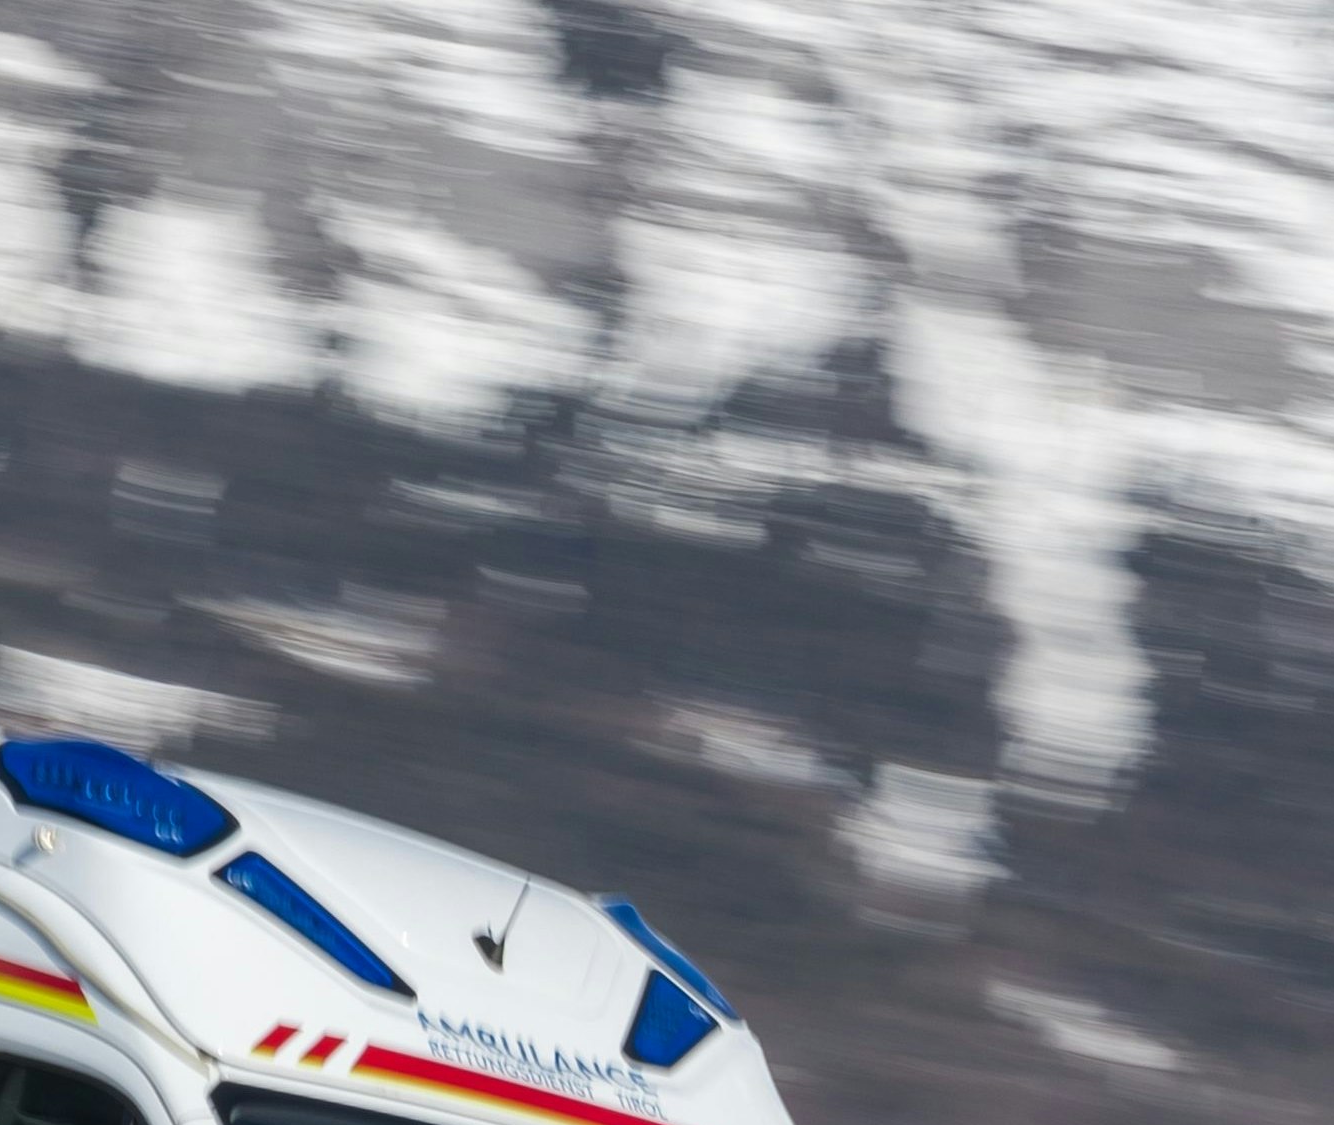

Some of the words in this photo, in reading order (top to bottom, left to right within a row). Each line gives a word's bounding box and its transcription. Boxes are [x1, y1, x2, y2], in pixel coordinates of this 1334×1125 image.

[417, 1008, 659, 1097] AMBULANCE
[428, 1039, 594, 1101] RETTUNGSDIENST
[617, 1092, 670, 1122] TIROL
